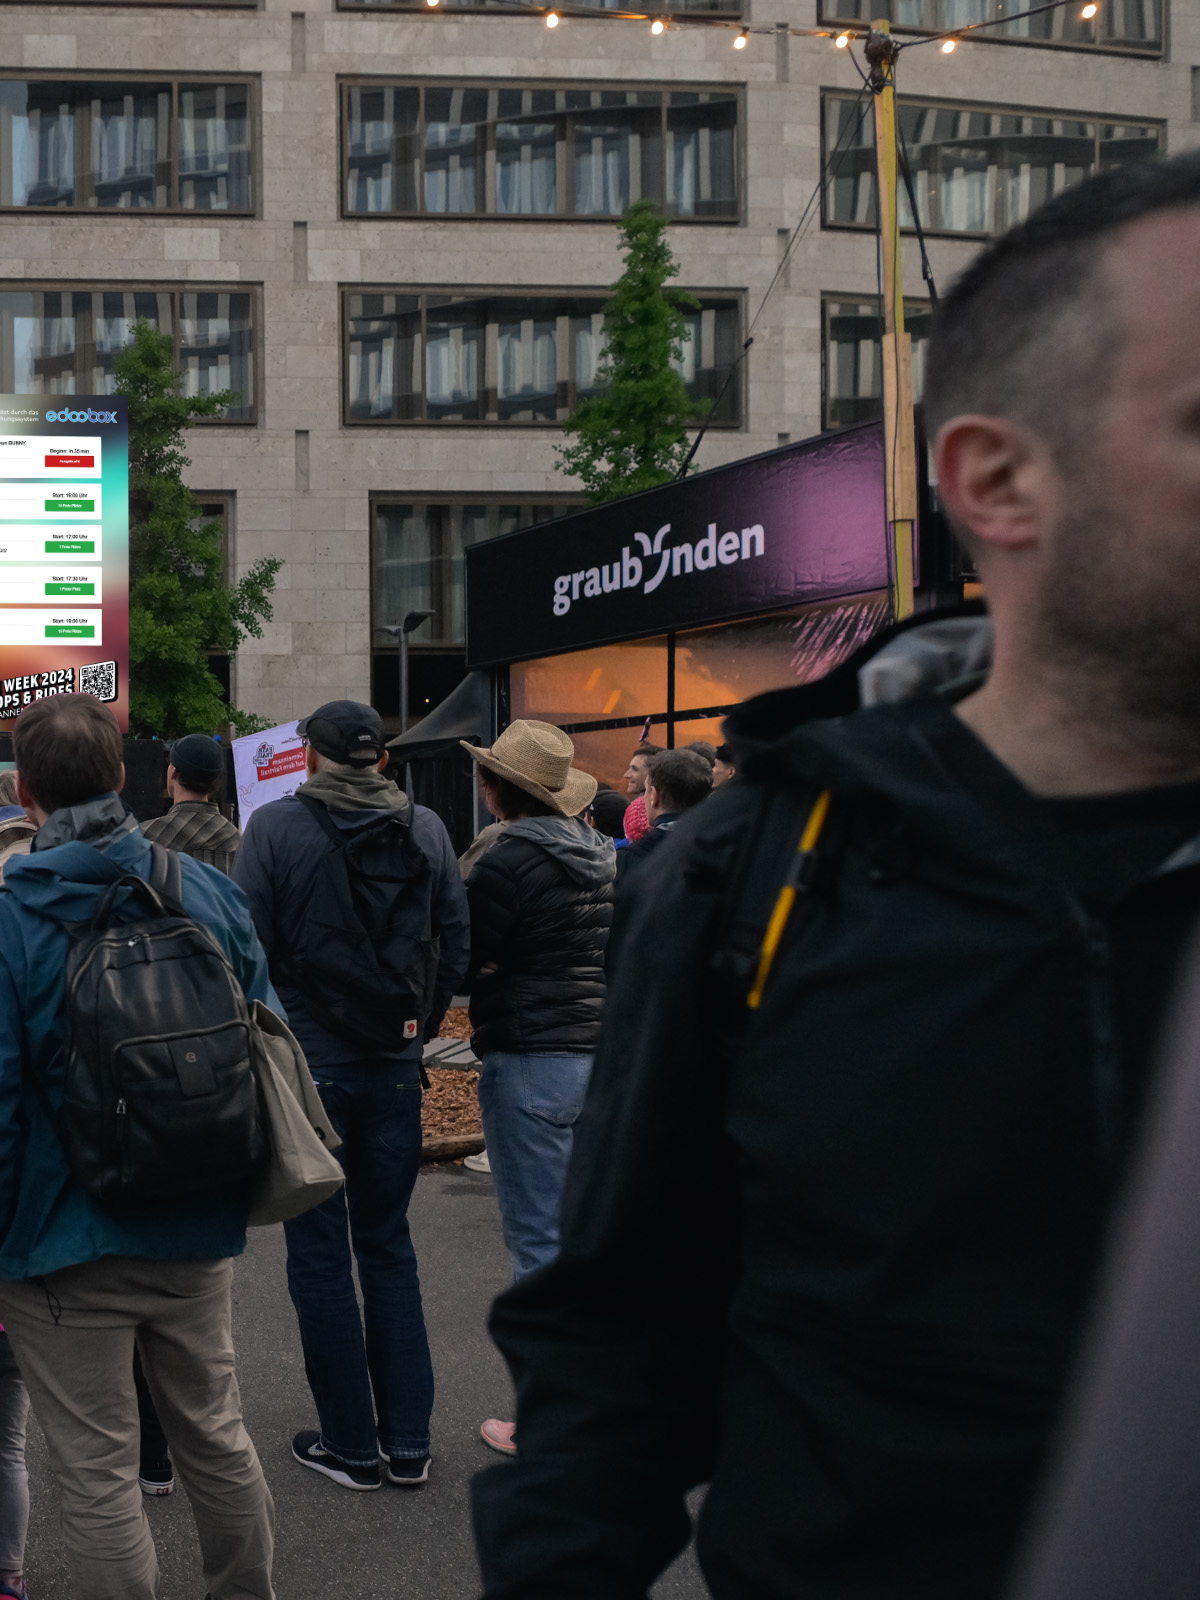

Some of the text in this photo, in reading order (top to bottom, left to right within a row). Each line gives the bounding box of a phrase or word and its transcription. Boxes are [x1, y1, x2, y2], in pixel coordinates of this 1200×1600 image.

[45, 407, 118, 424] edoobox
[3, 673, 40, 693] WEEK
[41, 667, 74, 687] 2024
[22, 691, 32, 706] &
